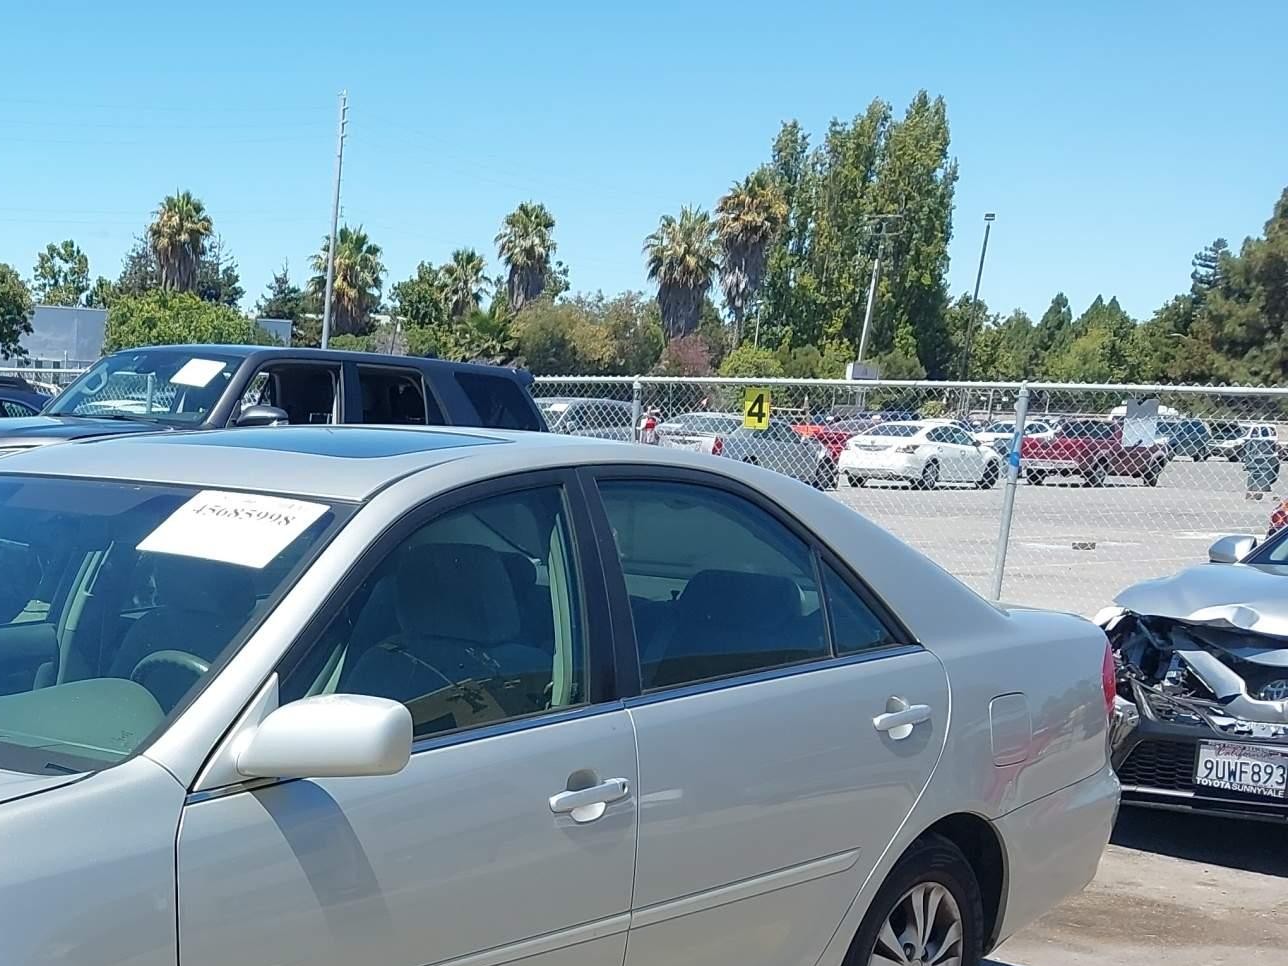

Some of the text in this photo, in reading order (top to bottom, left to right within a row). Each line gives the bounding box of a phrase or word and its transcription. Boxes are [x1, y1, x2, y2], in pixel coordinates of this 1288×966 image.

[747, 393, 766, 424] 4
[192, 503, 296, 526] 45685998
[1203, 758, 1286, 786] 9UWF893
[1196, 776, 1286, 798] TOYOTA SUNNYVALE
